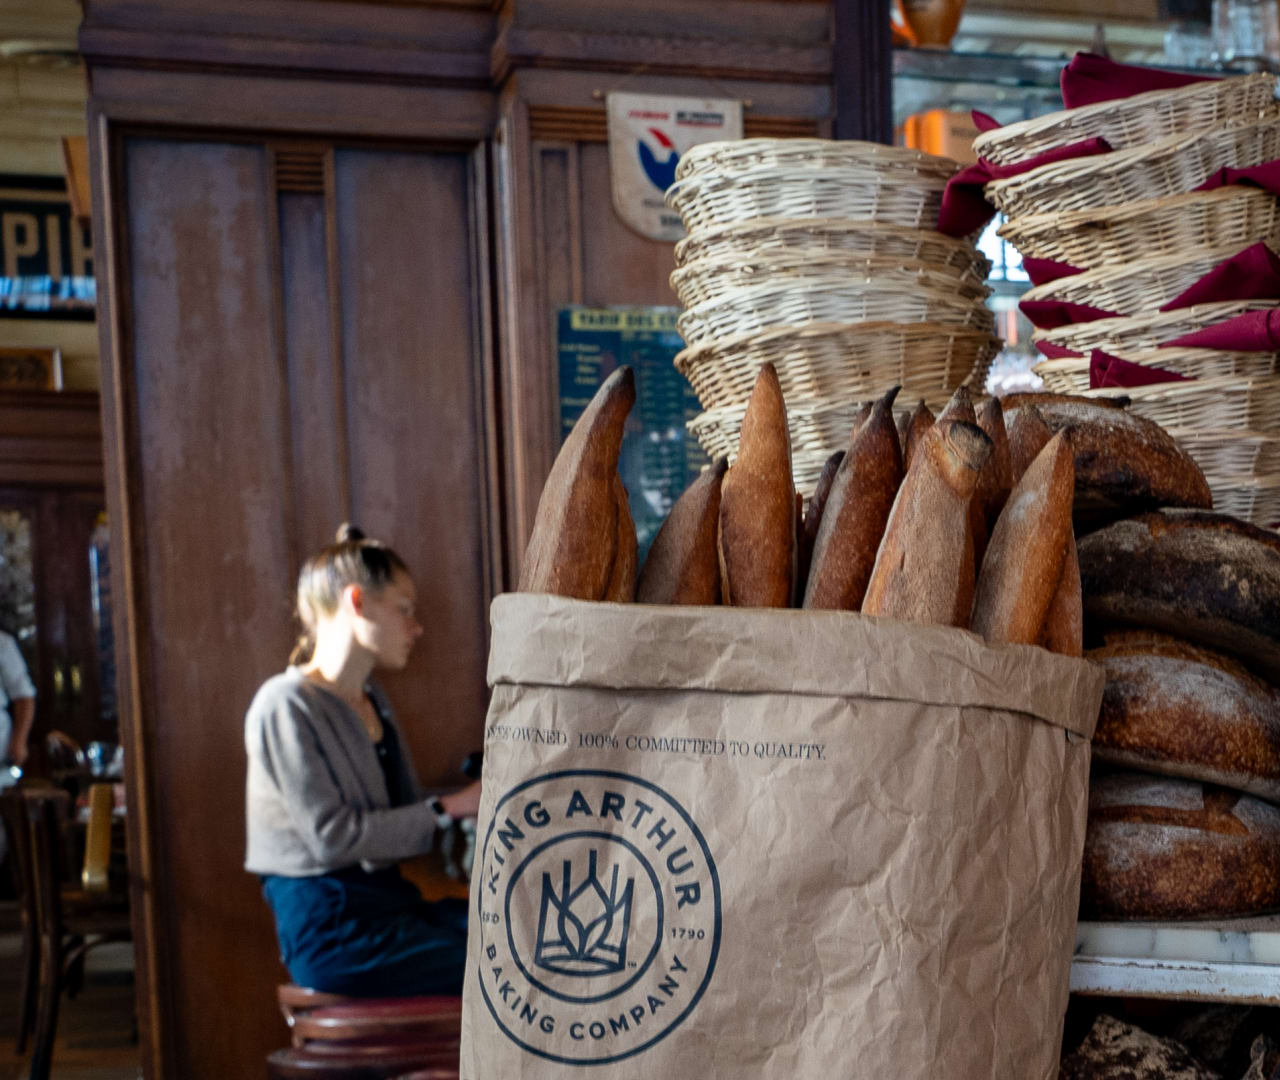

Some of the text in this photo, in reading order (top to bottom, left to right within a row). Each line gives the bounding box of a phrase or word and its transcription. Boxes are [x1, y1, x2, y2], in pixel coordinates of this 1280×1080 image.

[578, 731, 619, 749] 100%
[625, 734, 725, 756] COMMITTED
[730, 740, 749, 758] TO
[754, 742, 826, 761] QUALITY.
[565, 789, 702, 911] ARTHUR
[671, 927, 705, 940] 1790
[486, 943, 689, 1041] BAKING COMPANY
